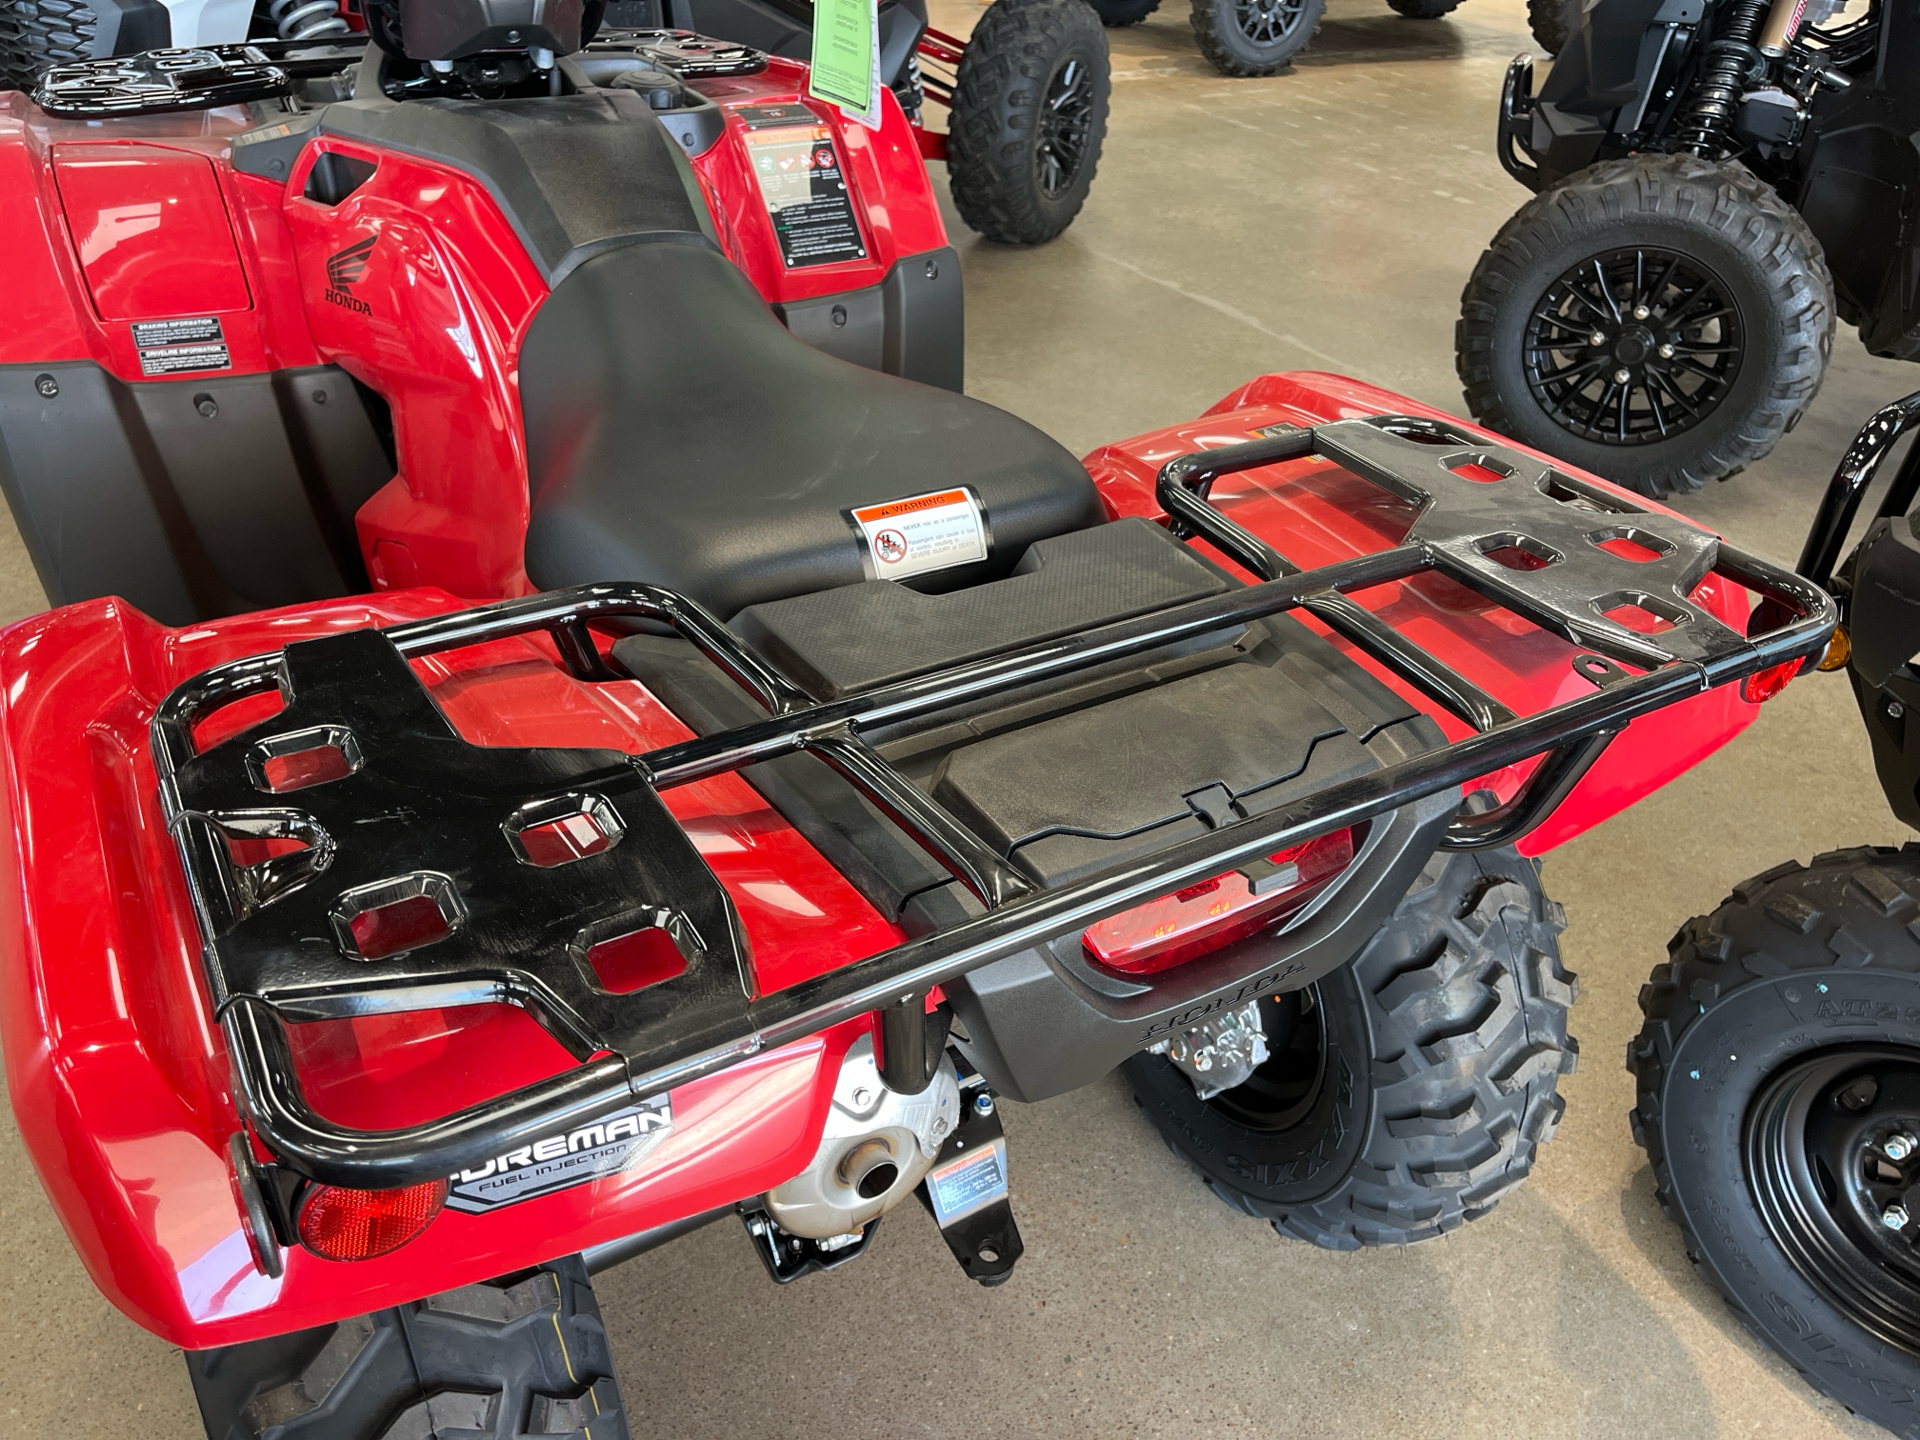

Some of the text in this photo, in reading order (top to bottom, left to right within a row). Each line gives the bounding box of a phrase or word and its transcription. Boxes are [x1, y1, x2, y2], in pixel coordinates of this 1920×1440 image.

[1788, 0, 1807, 38] HOWA
[325, 288, 373, 317] HONDA
[892, 496, 946, 513] WARNING
[903, 522, 921, 531] NEVER
[908, 536, 934, 546] Passengers
[946, 530, 959, 538] cause
[911, 551, 931, 560] SEVERE
[933, 546, 951, 554] INJURY
[1136, 960, 1307, 1044] HONDA
[1226, 1047, 1354, 1188] MAXXIS
[450, 1106, 672, 1184] OREMAN
[479, 1143, 628, 1192] FUEL INJECTION
